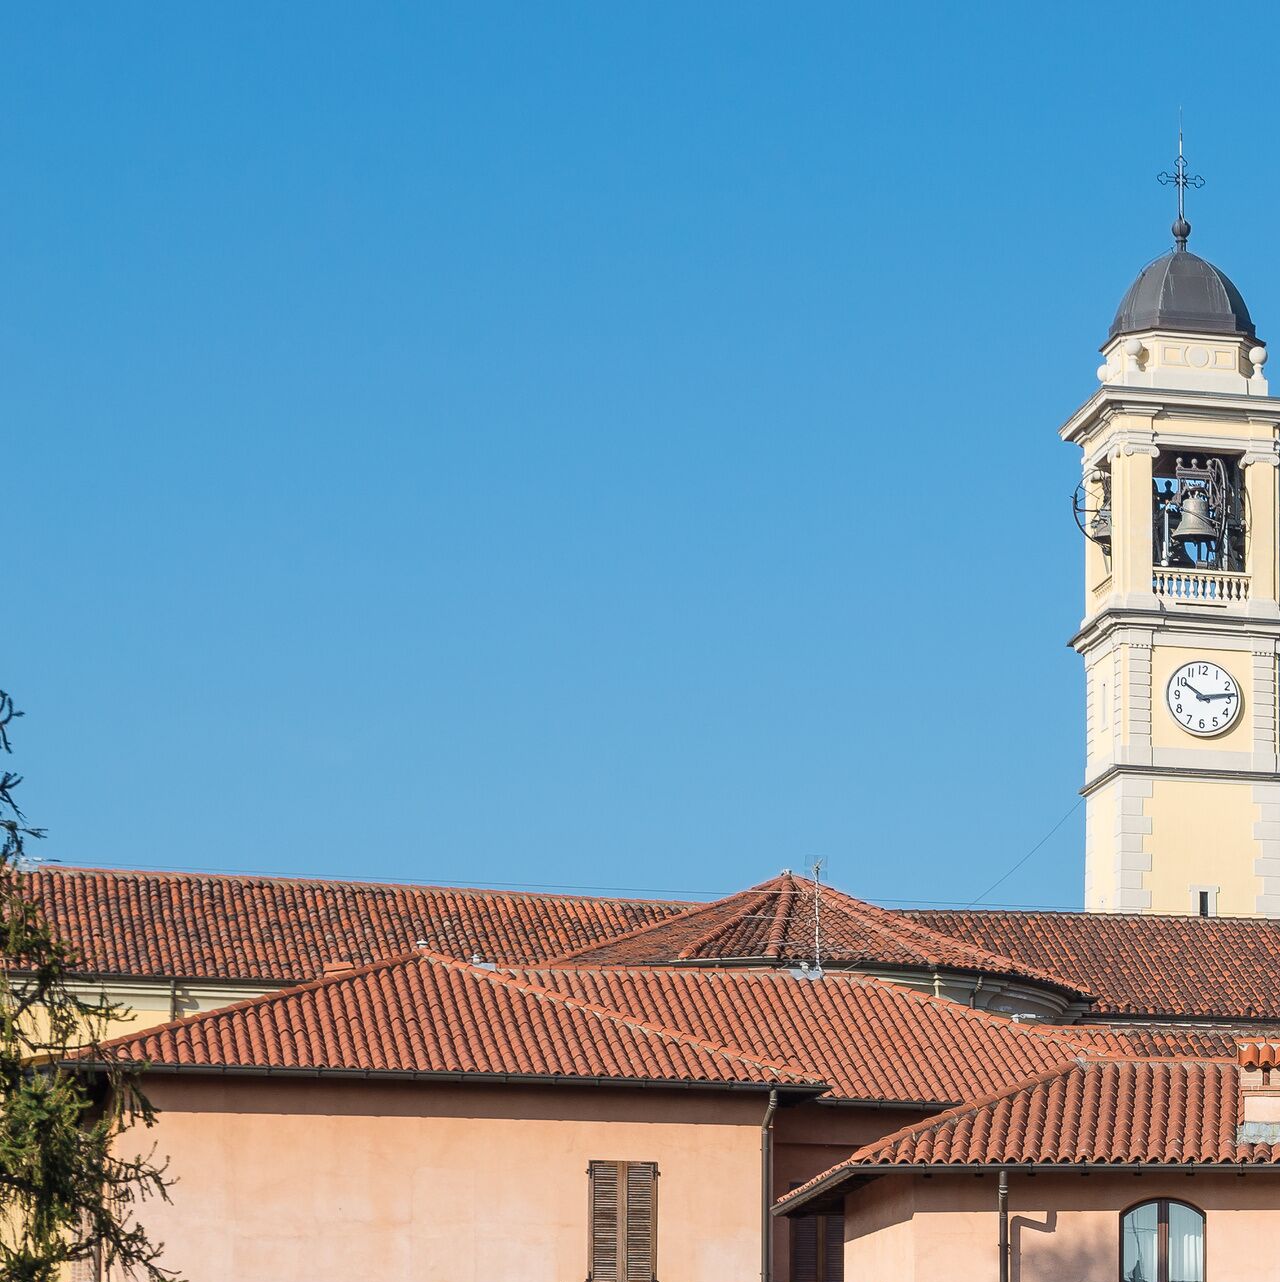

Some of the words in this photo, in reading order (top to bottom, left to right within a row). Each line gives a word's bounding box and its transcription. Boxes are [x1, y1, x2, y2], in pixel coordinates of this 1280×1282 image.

[1187, 667, 1194, 678] 11
[1198, 665, 1208, 676] 12
[1177, 676, 1187, 687] 10
[1224, 680, 1231, 691] 2
[1174, 689, 1181, 700] 9
[1175, 703, 1183, 713] 8
[1222, 707, 1229, 718] 4
[1186, 714, 1193, 725] 7
[1198, 718, 1206, 729] 6
[1212, 716, 1219, 727] 5
